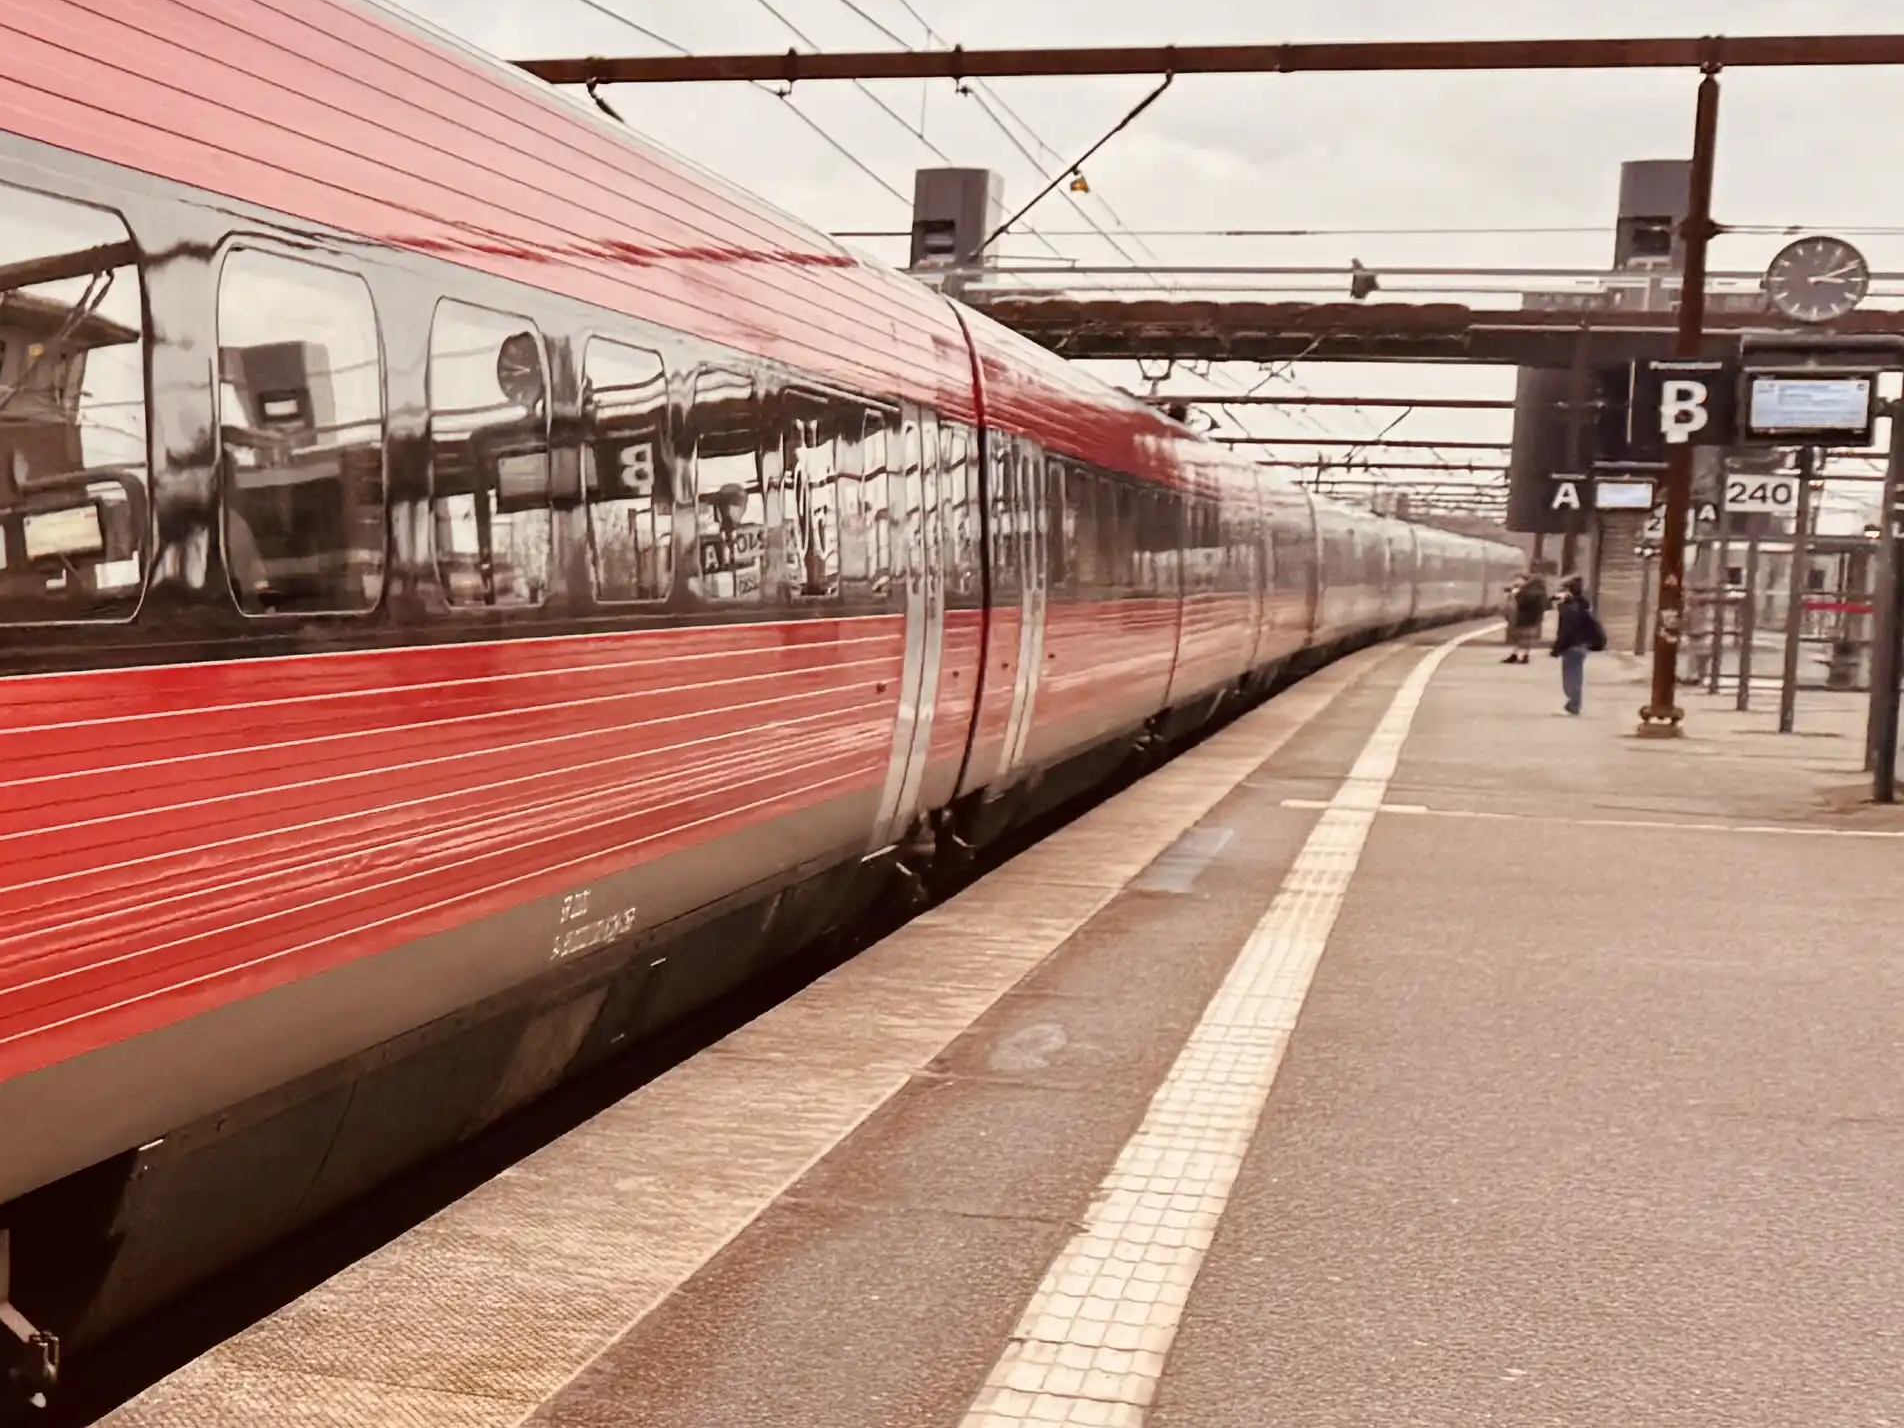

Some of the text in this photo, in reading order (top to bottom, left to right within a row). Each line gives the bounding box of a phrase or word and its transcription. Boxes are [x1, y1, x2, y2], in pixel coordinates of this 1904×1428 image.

[1660, 380, 1709, 434] B
[1551, 482, 1581, 510] A
[1727, 481, 1792, 505] 240
[1698, 503, 1717, 521] A
